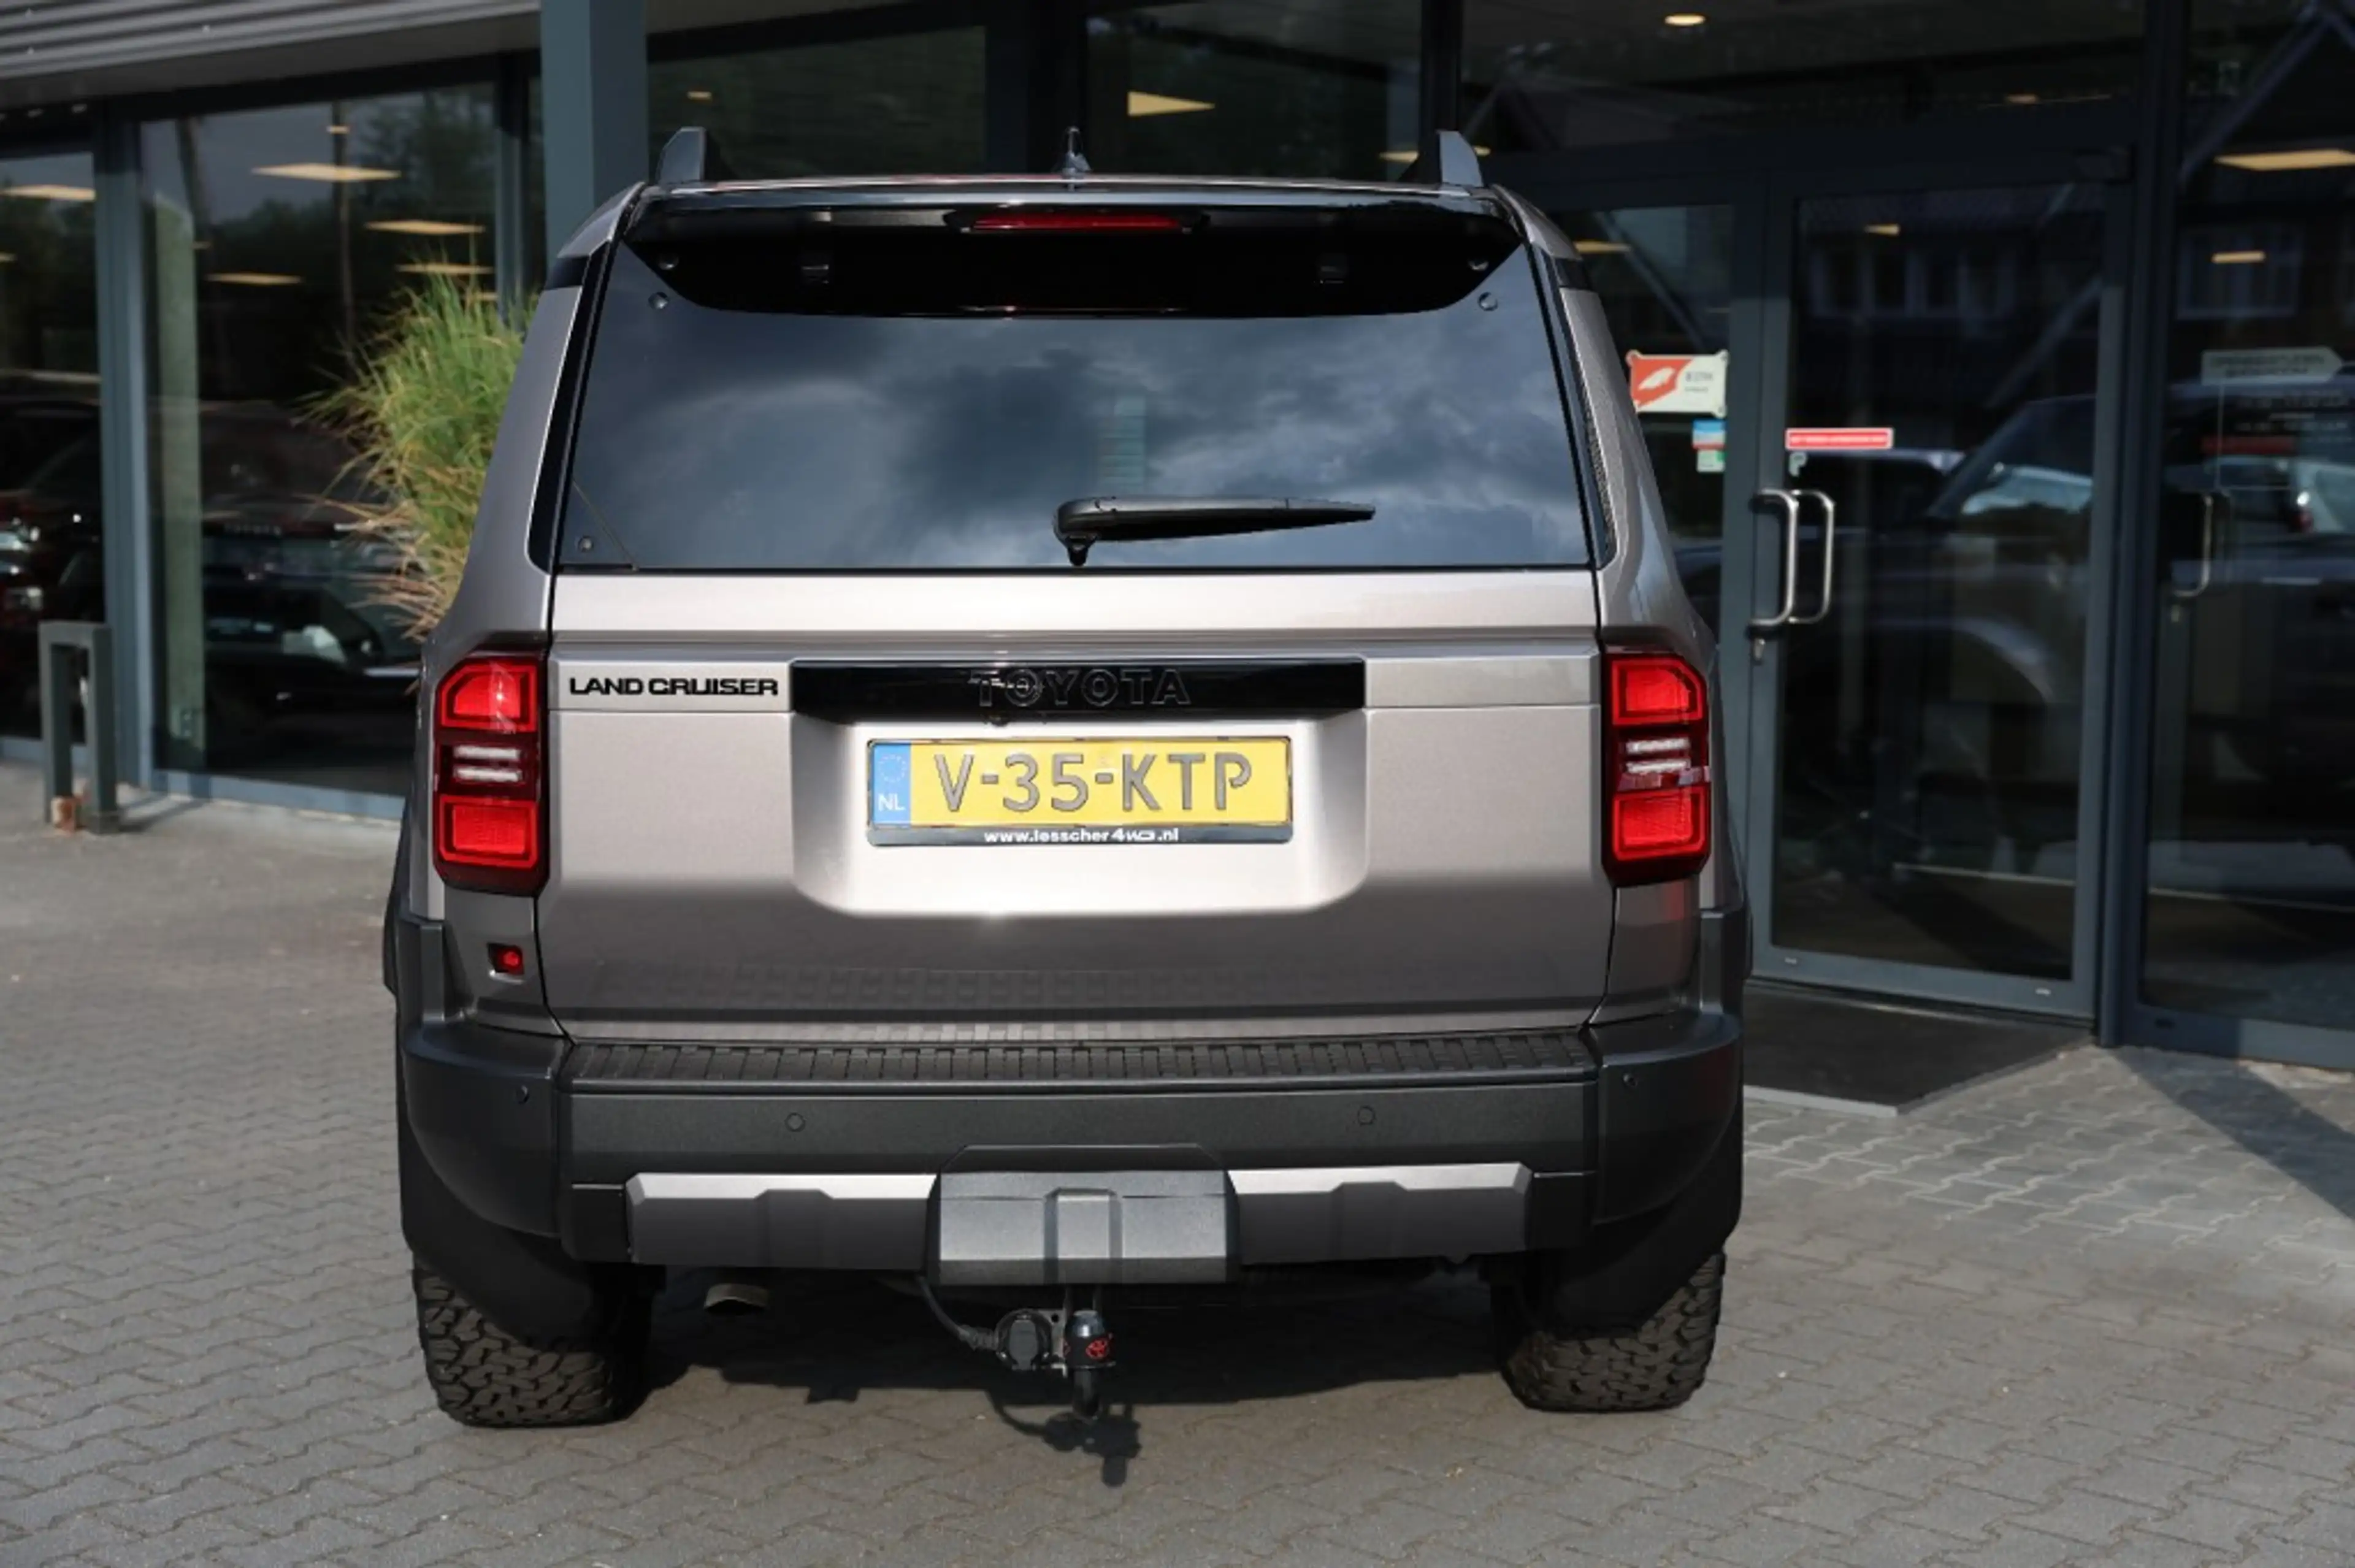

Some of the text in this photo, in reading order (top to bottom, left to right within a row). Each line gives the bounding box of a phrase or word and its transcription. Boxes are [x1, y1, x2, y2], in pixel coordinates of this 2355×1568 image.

[570, 678, 778, 695] LAND CRUISER
[968, 668, 1191, 706] TOYOTA
[934, 753, 1252, 813] V-35-KTP
[878, 794, 905, 811] NL
